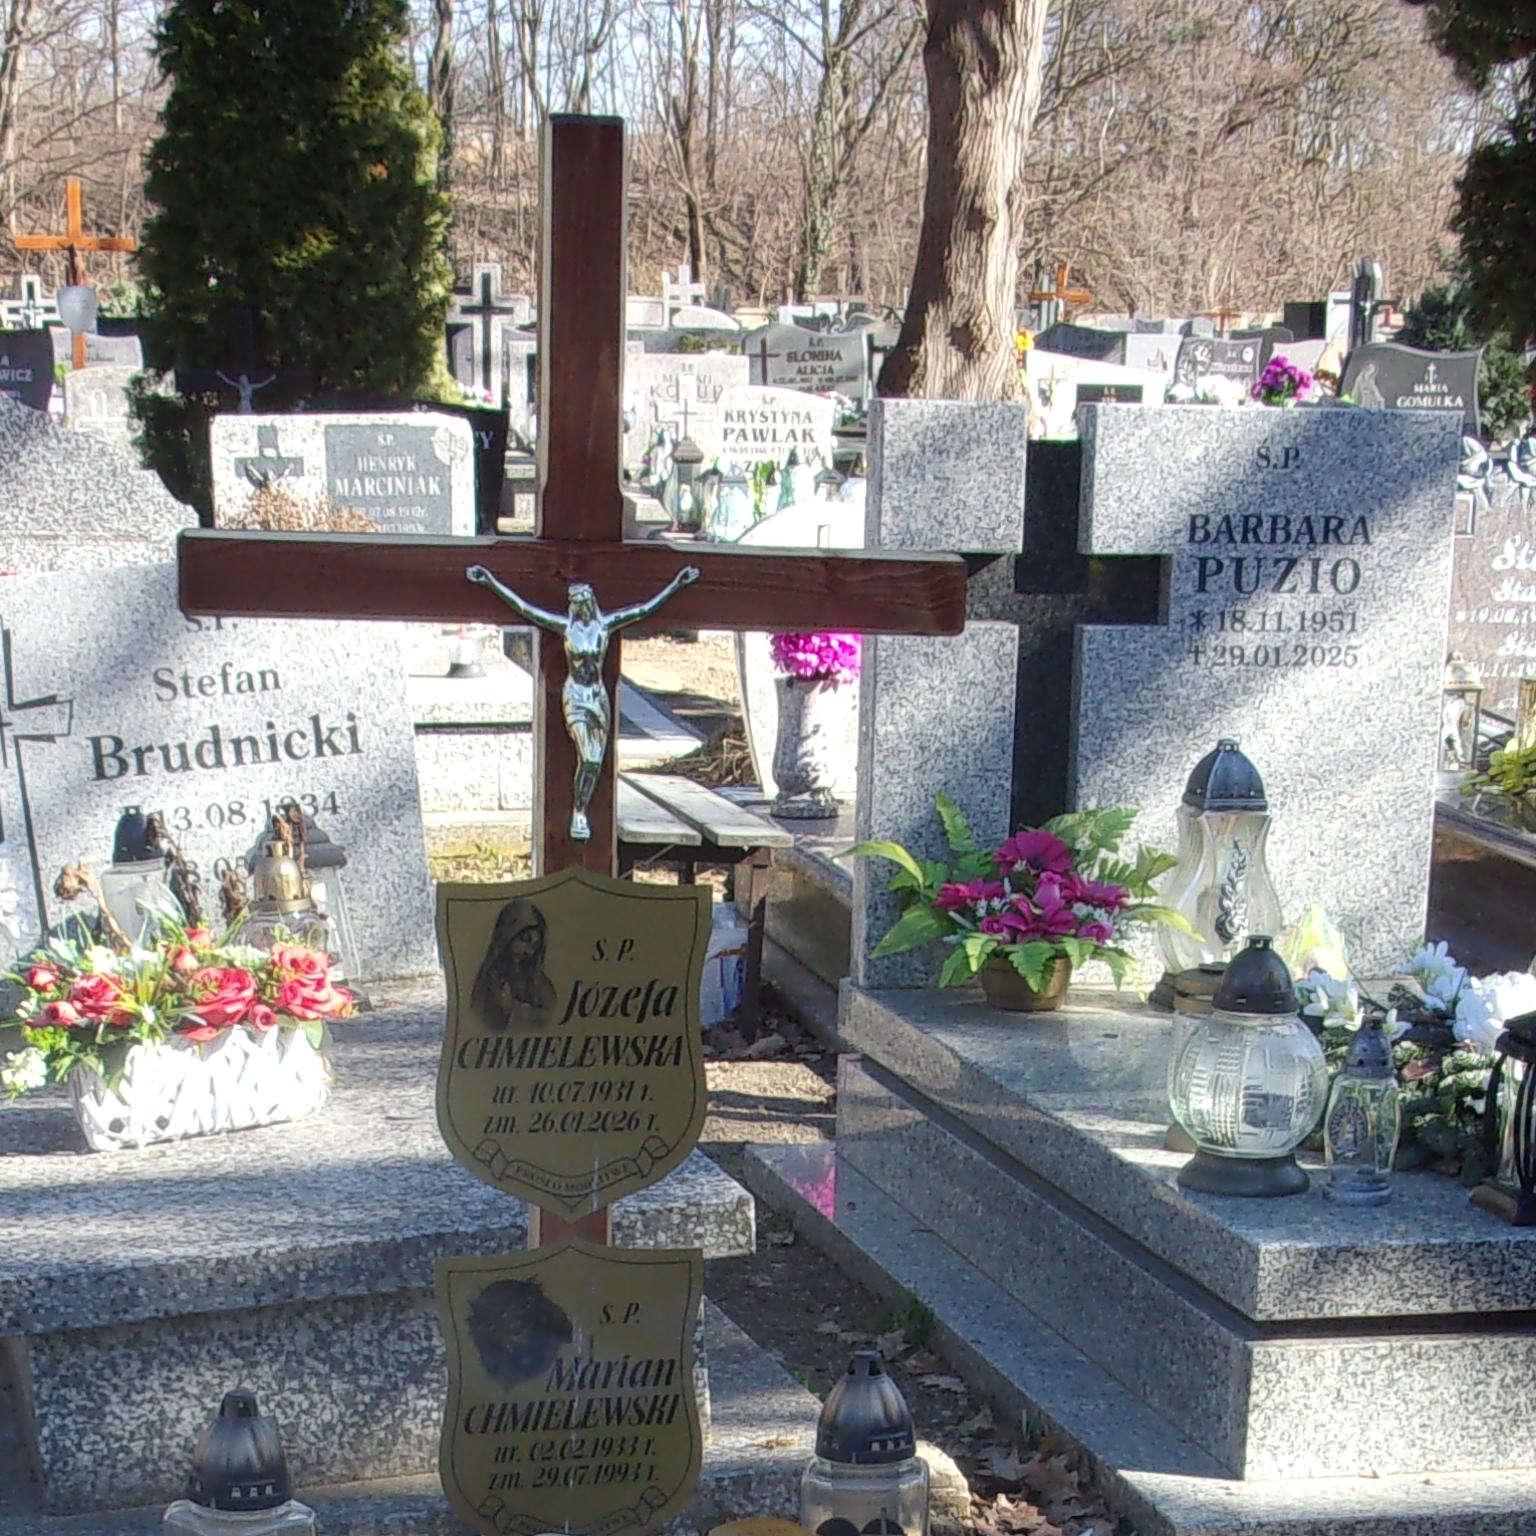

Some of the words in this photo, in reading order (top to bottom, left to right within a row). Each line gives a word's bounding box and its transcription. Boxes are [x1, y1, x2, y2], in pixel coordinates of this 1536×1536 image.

[724, 409, 813, 425] KRYSTYNA
[722, 427, 816, 443] PAWLAK
[357, 454, 418, 473] HENRYK
[334, 475, 442, 496] MARCINIAK
[1188, 514, 1373, 546] BARBARA
[1190, 555, 1362, 595] PUZIO
[152, 661, 282, 703] Stefan
[85, 711, 365, 782] Brudnicki
[558, 977, 679, 1027] Józefa
[456, 1035, 684, 1070] CHMIELEWSKA
[491, 1084, 520, 1105] ur.
[529, 1080, 636, 1105] 10.07.1931
[482, 1114, 521, 1135] zm.
[527, 1111, 641, 1134] 26.01.2026
[544, 1353, 678, 1394] Marian
[463, 1394, 681, 1436] CHMIELEWSKI
[493, 1443, 522, 1464] ur.
[528, 1436, 642, 1462] 02.02.1933
[486, 1471, 524, 1491] zm.
[531, 1462, 642, 1489] 29.07.1993
